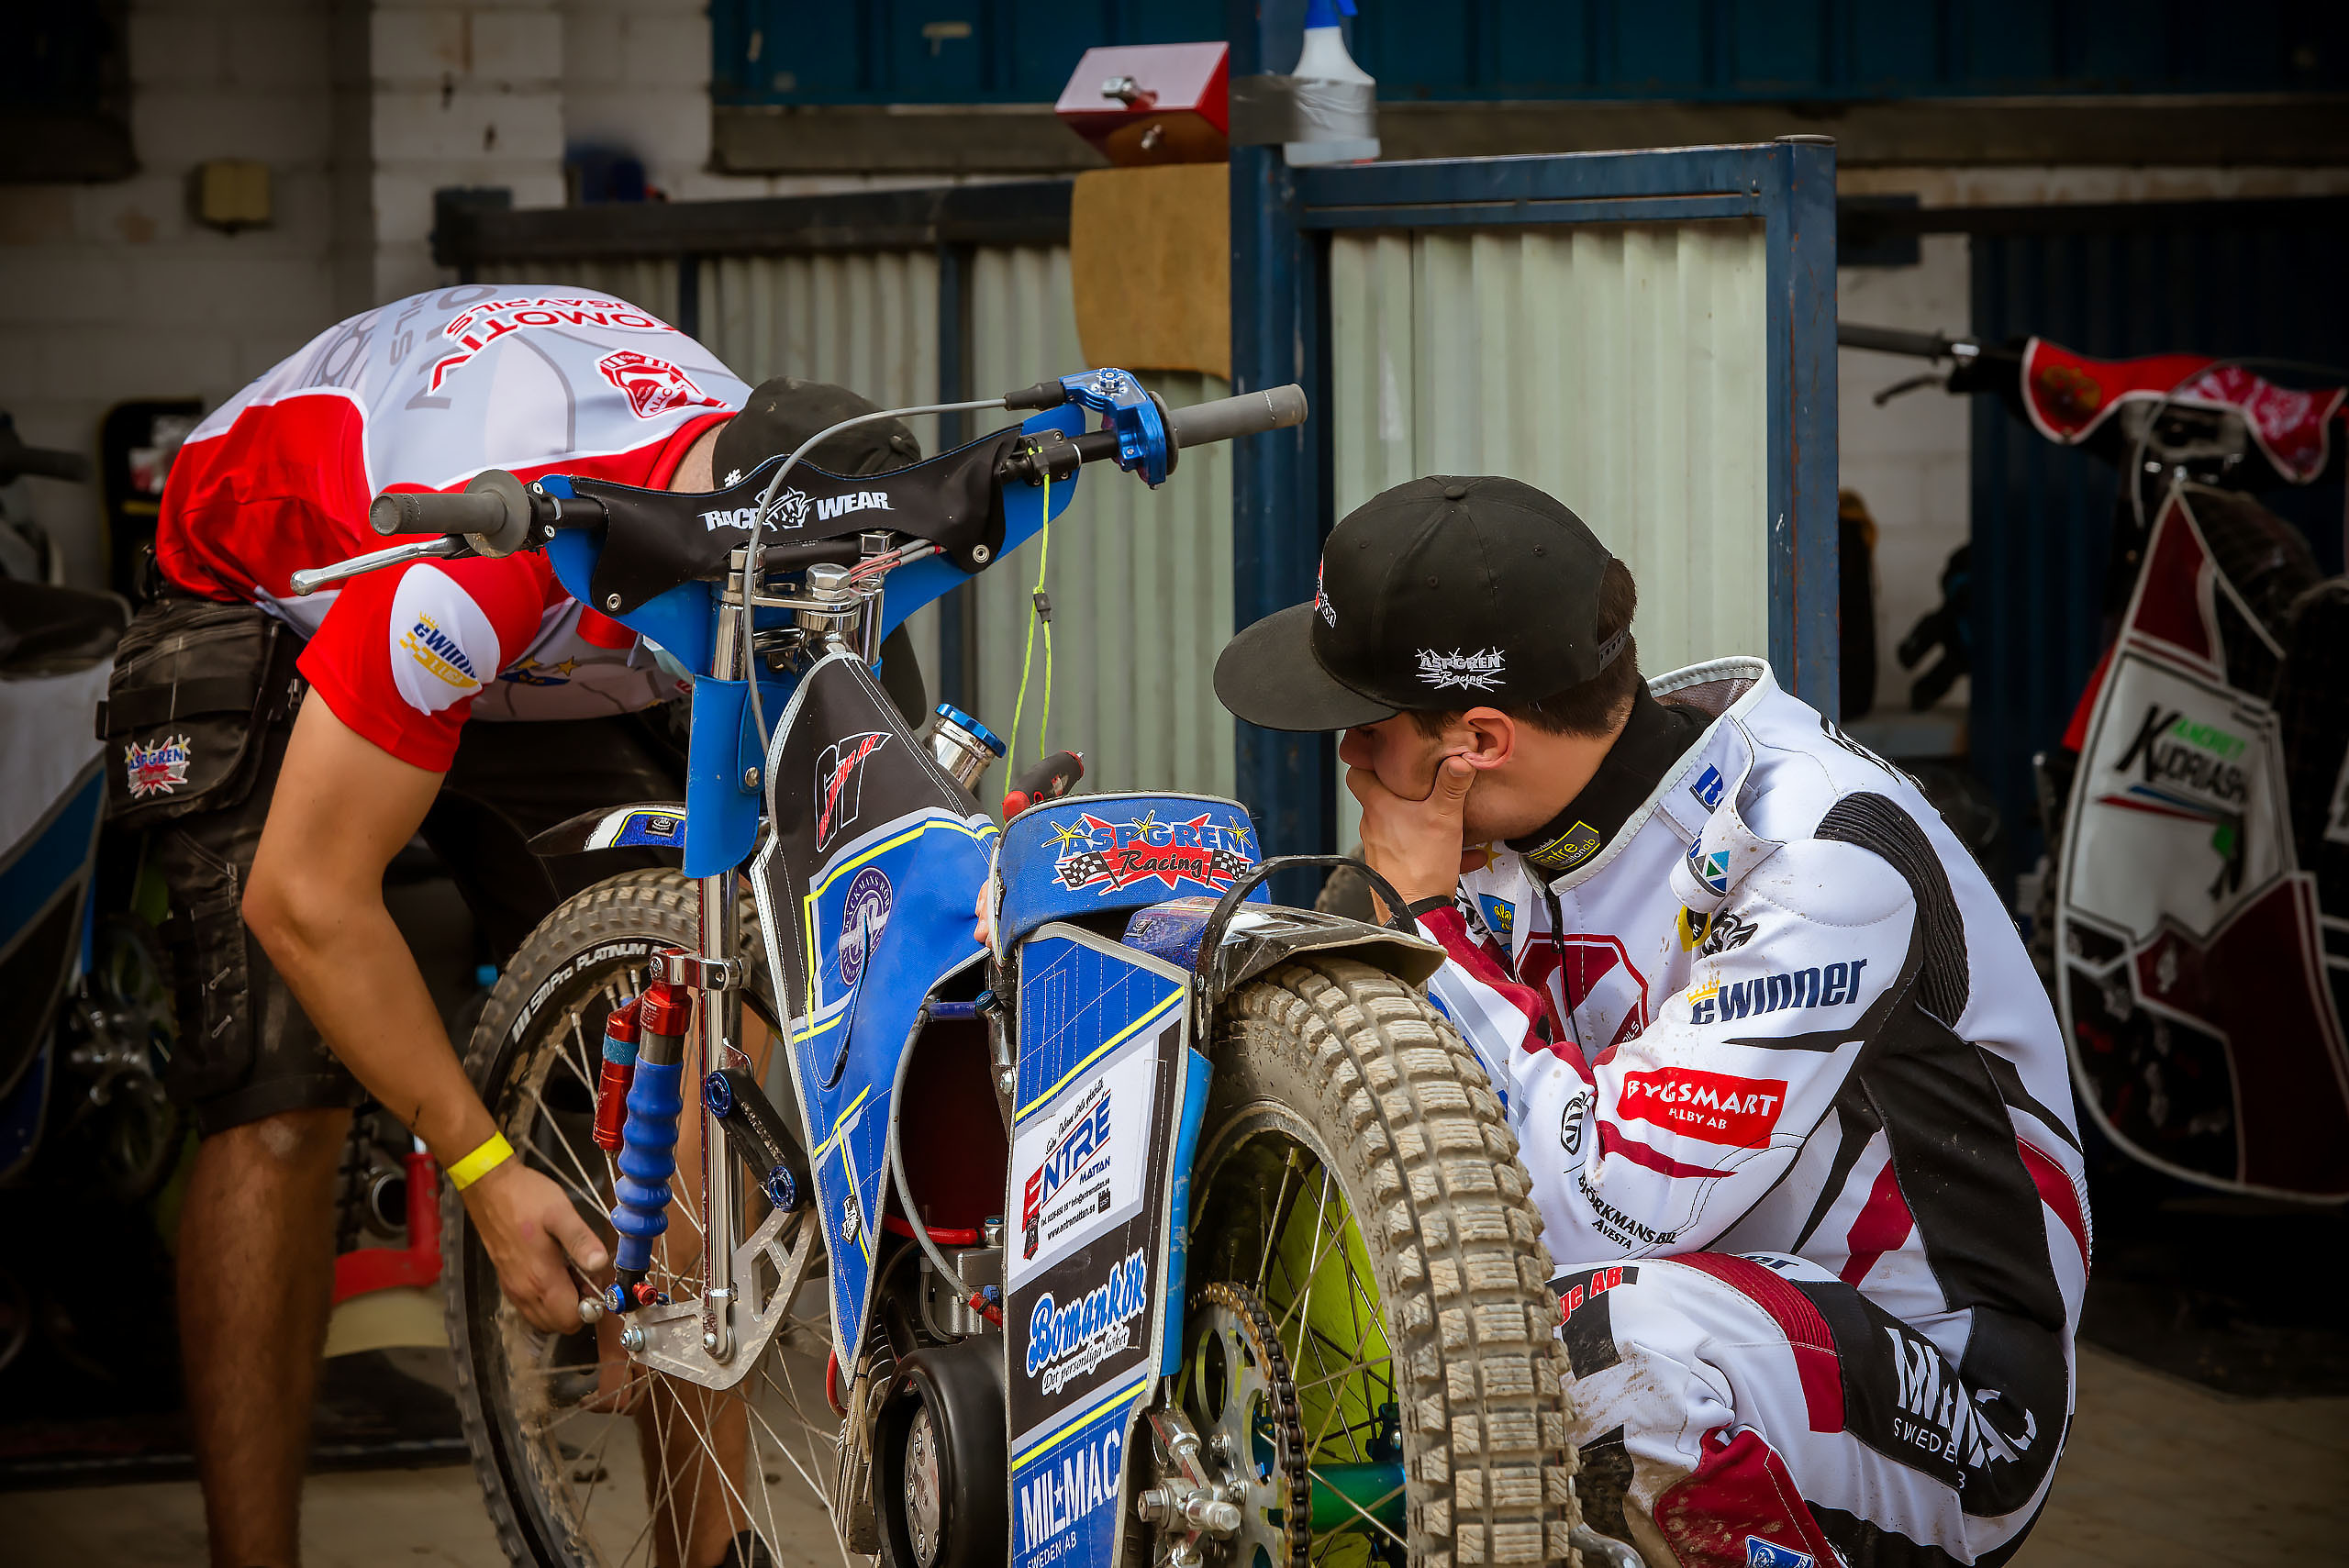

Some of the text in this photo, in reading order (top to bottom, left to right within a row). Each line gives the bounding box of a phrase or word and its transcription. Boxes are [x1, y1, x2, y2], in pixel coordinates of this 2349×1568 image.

[817, 492, 896, 521] WEAR
[1420, 656, 1500, 670] ASPGREN
[1440, 671, 1483, 684] Racing
[1065, 824, 1245, 855] ASPGREN
[1119, 850, 1203, 878] Racing
[575, 943, 648, 973] PLATINUM
[1689, 958, 1868, 1025] eWinner
[1706, 1116, 1728, 1129] AB
[1079, 1155, 1111, 1184] MATTAN
[1592, 1218, 1632, 1250] AVESTA
[1589, 1266, 1624, 1299] AB
[1894, 1418, 1956, 1463] SWEDE
[1027, 1530, 1077, 1568] SWEDEN AB
